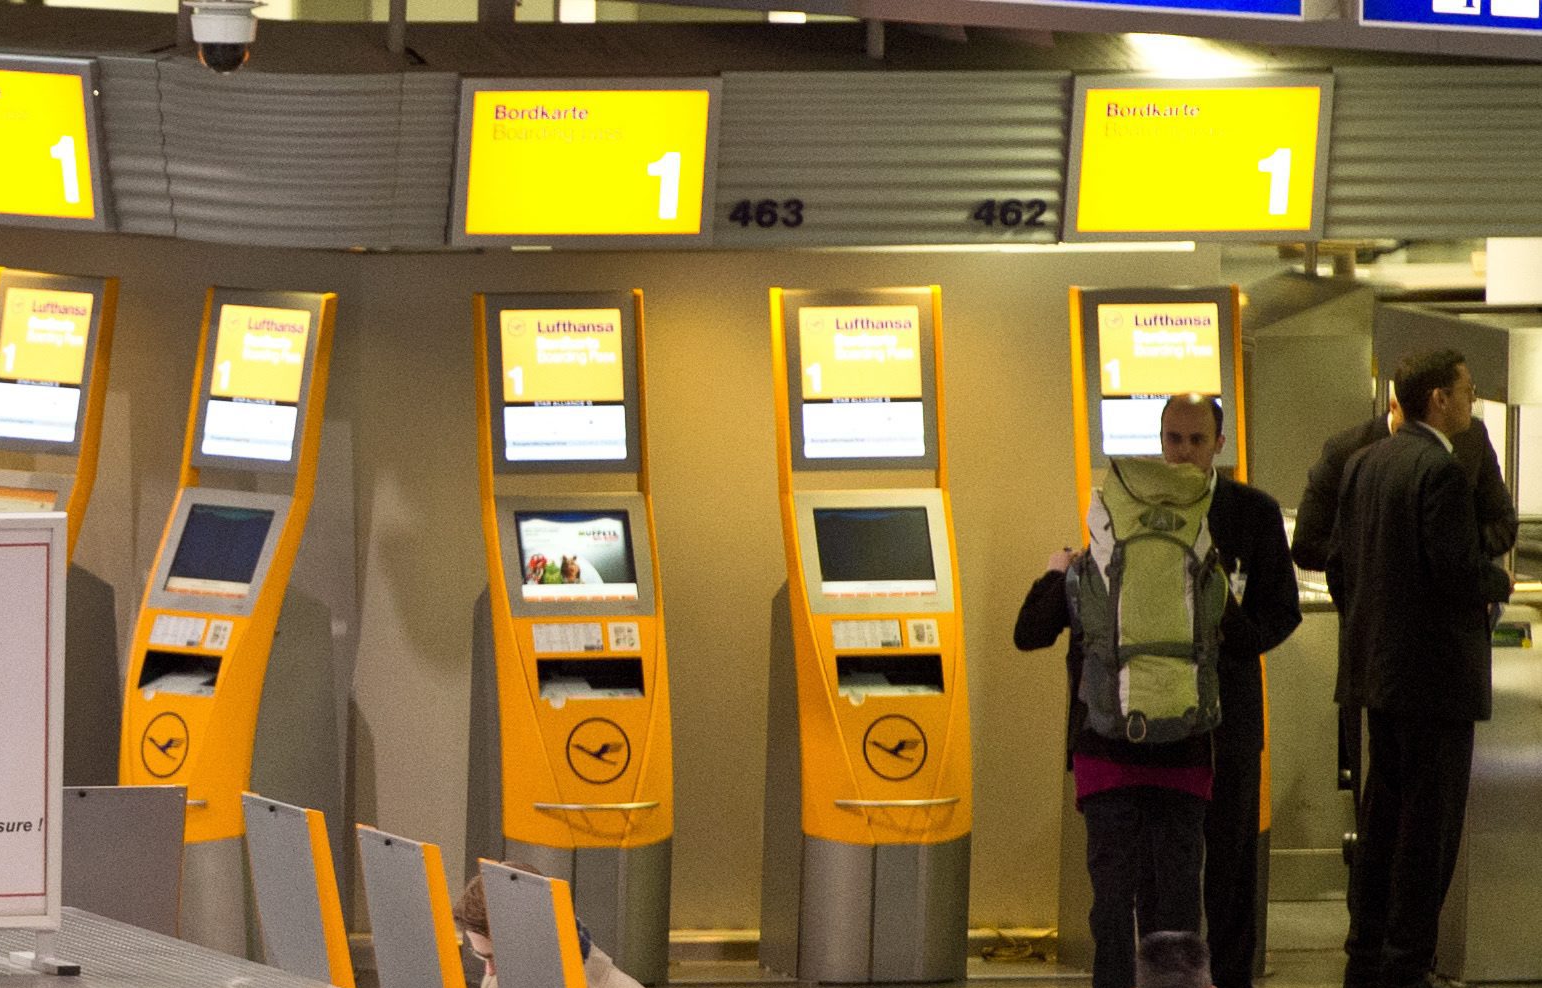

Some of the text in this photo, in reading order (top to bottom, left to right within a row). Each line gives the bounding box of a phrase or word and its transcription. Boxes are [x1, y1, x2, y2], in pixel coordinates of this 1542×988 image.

[495, 105, 589, 121] Bordkarte
[1106, 102, 1201, 118] Bordkarte
[50, 135, 80, 204] 1
[1258, 148, 1292, 215] 1
[647, 151, 681, 219] 1
[728, 198, 805, 228] 463
[973, 198, 1048, 227] 462
[31, 299, 88, 317] Lufthansa
[1134, 313, 1212, 327] Lufthansa
[247, 316, 305, 334] Lufthansa
[537, 320, 614, 333] Lufthansa
[835, 317, 912, 331] Lufthansa
[2, 343, 16, 373] 1
[217, 360, 232, 390] 1
[507, 366, 524, 396] 1
[805, 362, 821, 394] 1
[1104, 358, 1120, 390] 1
[37, 817, 43, 832] !
